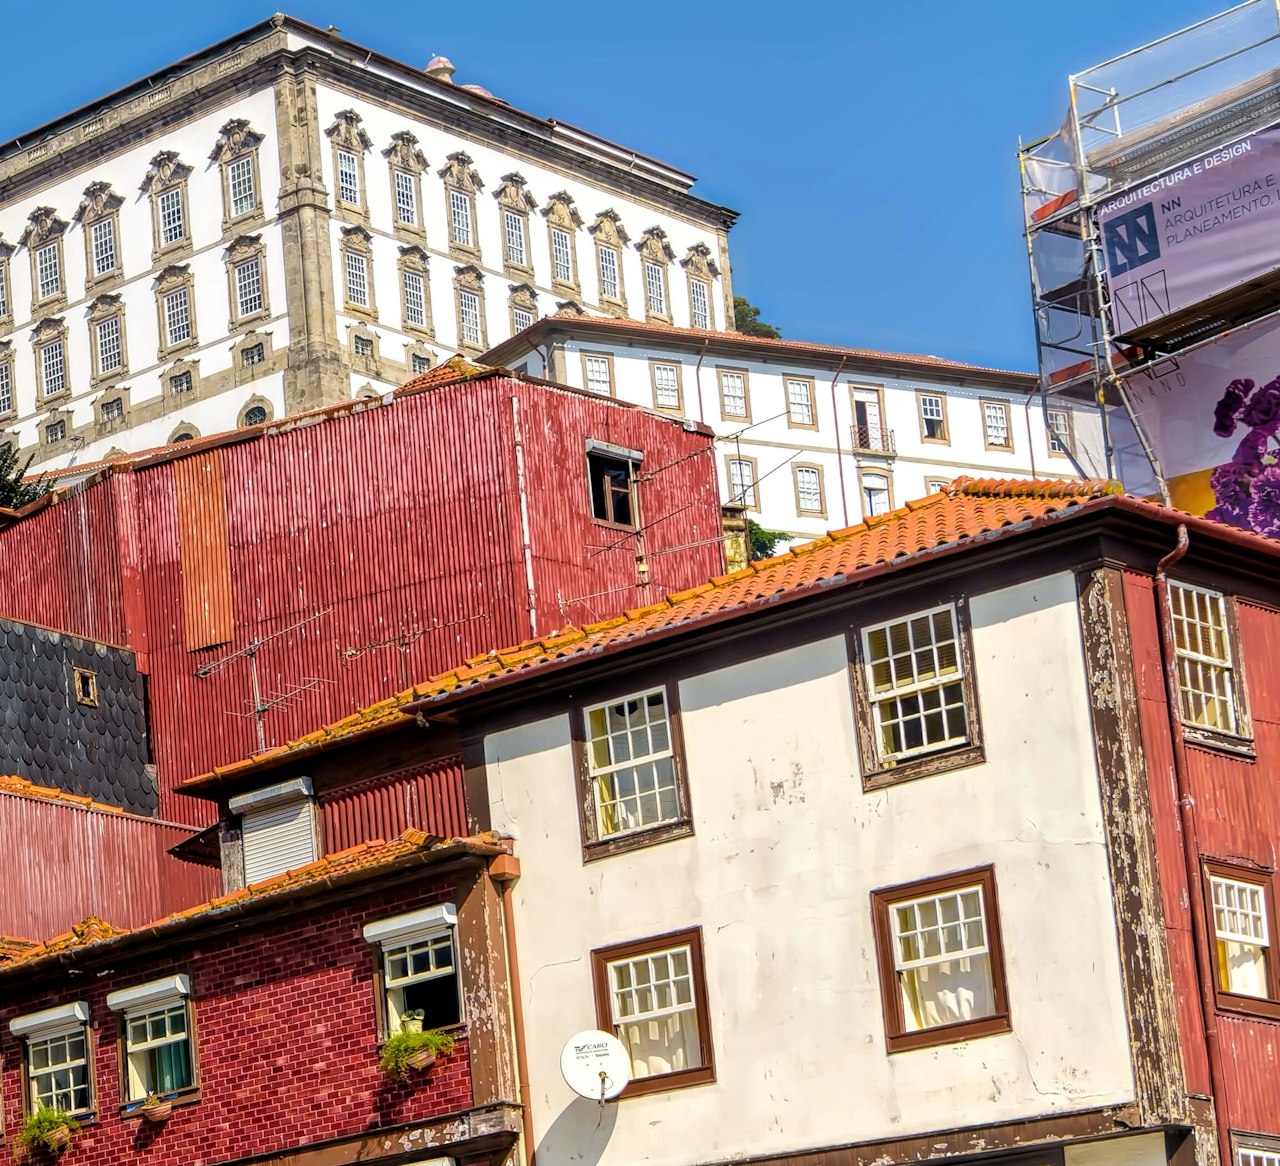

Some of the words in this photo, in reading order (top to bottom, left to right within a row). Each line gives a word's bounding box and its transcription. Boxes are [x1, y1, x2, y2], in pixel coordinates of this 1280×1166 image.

[1100, 167, 1192, 216] ARQUITECTURA
[1193, 162, 1203, 175] E
[1204, 140, 1252, 170] DESIGN
[1161, 197, 1182, 215] NN
[1164, 179, 1263, 231] ARQUITETURA
[1266, 173, 1277, 188] E
[1166, 193, 1274, 248] PLANEAMENTO,
